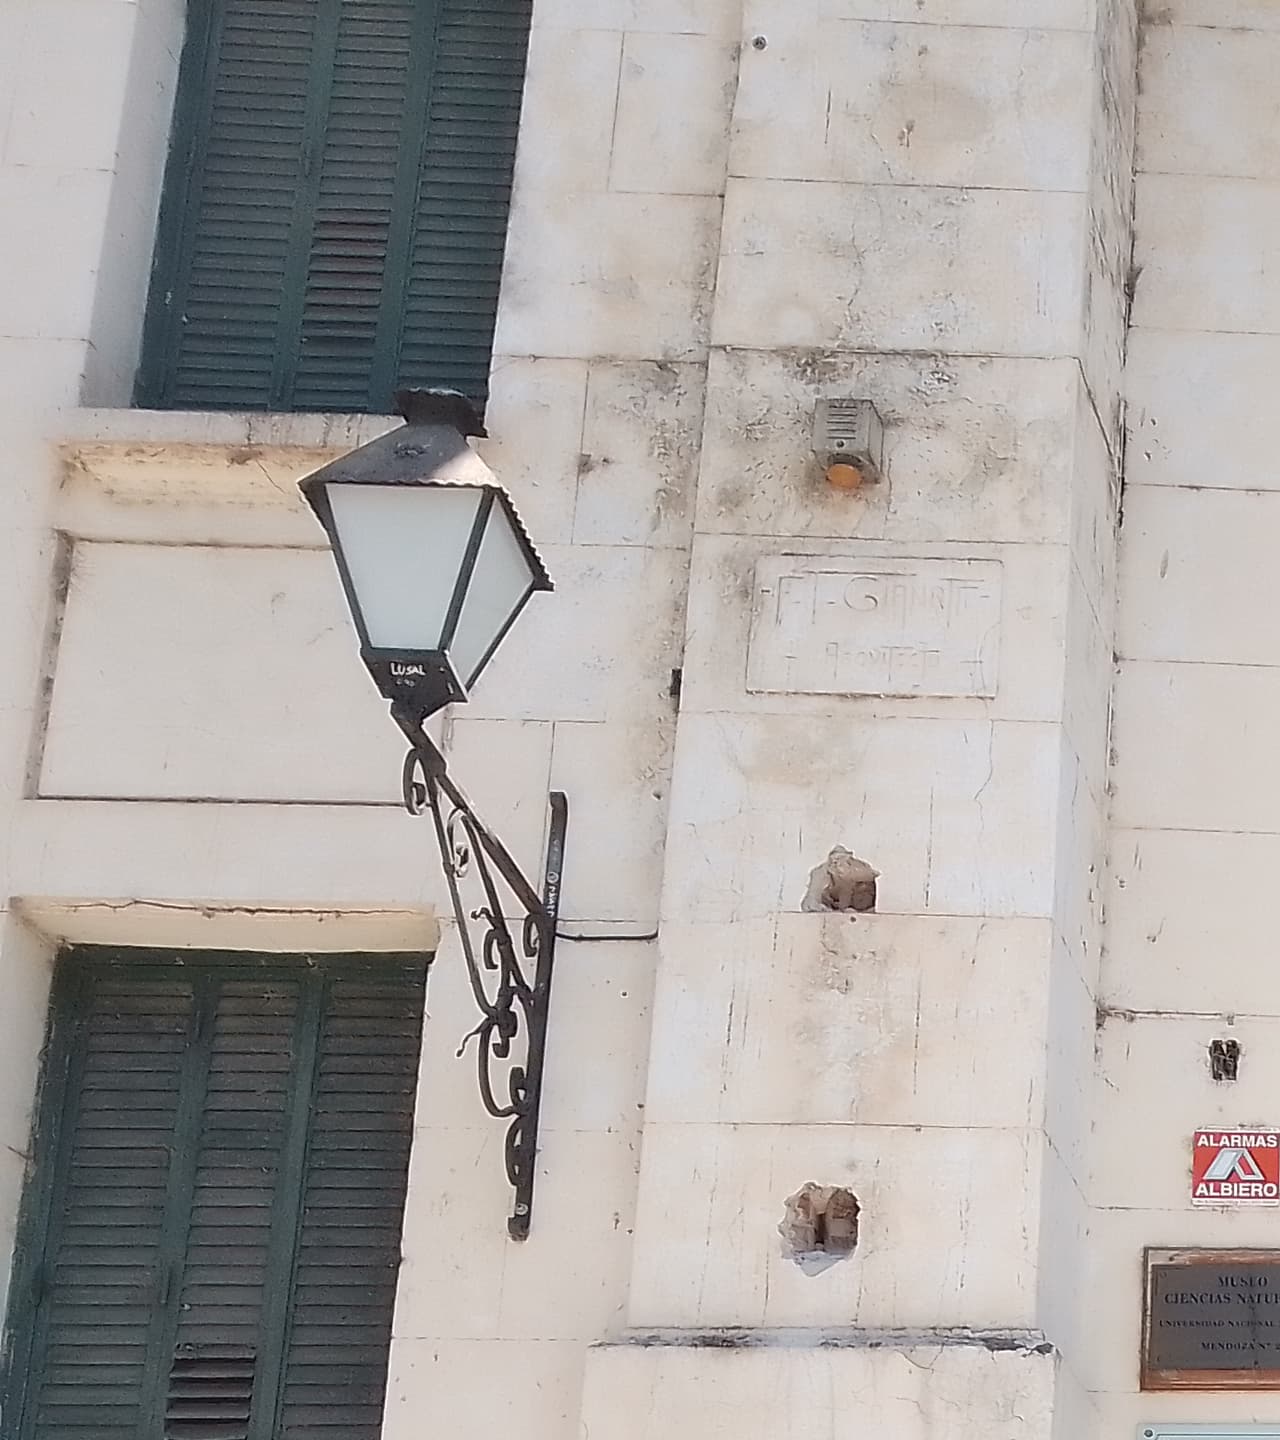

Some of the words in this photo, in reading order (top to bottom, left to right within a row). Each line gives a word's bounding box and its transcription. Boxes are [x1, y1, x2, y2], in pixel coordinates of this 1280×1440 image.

[1197, 1134, 1278, 1148] ALARMAS
[1195, 1183, 1278, 1197] ALBIERO
[1218, 1276, 1268, 1288] MUSEO
[1164, 1293, 1231, 1305] CIENCIAS
[1201, 1342, 1255, 1351] MENDOZA
